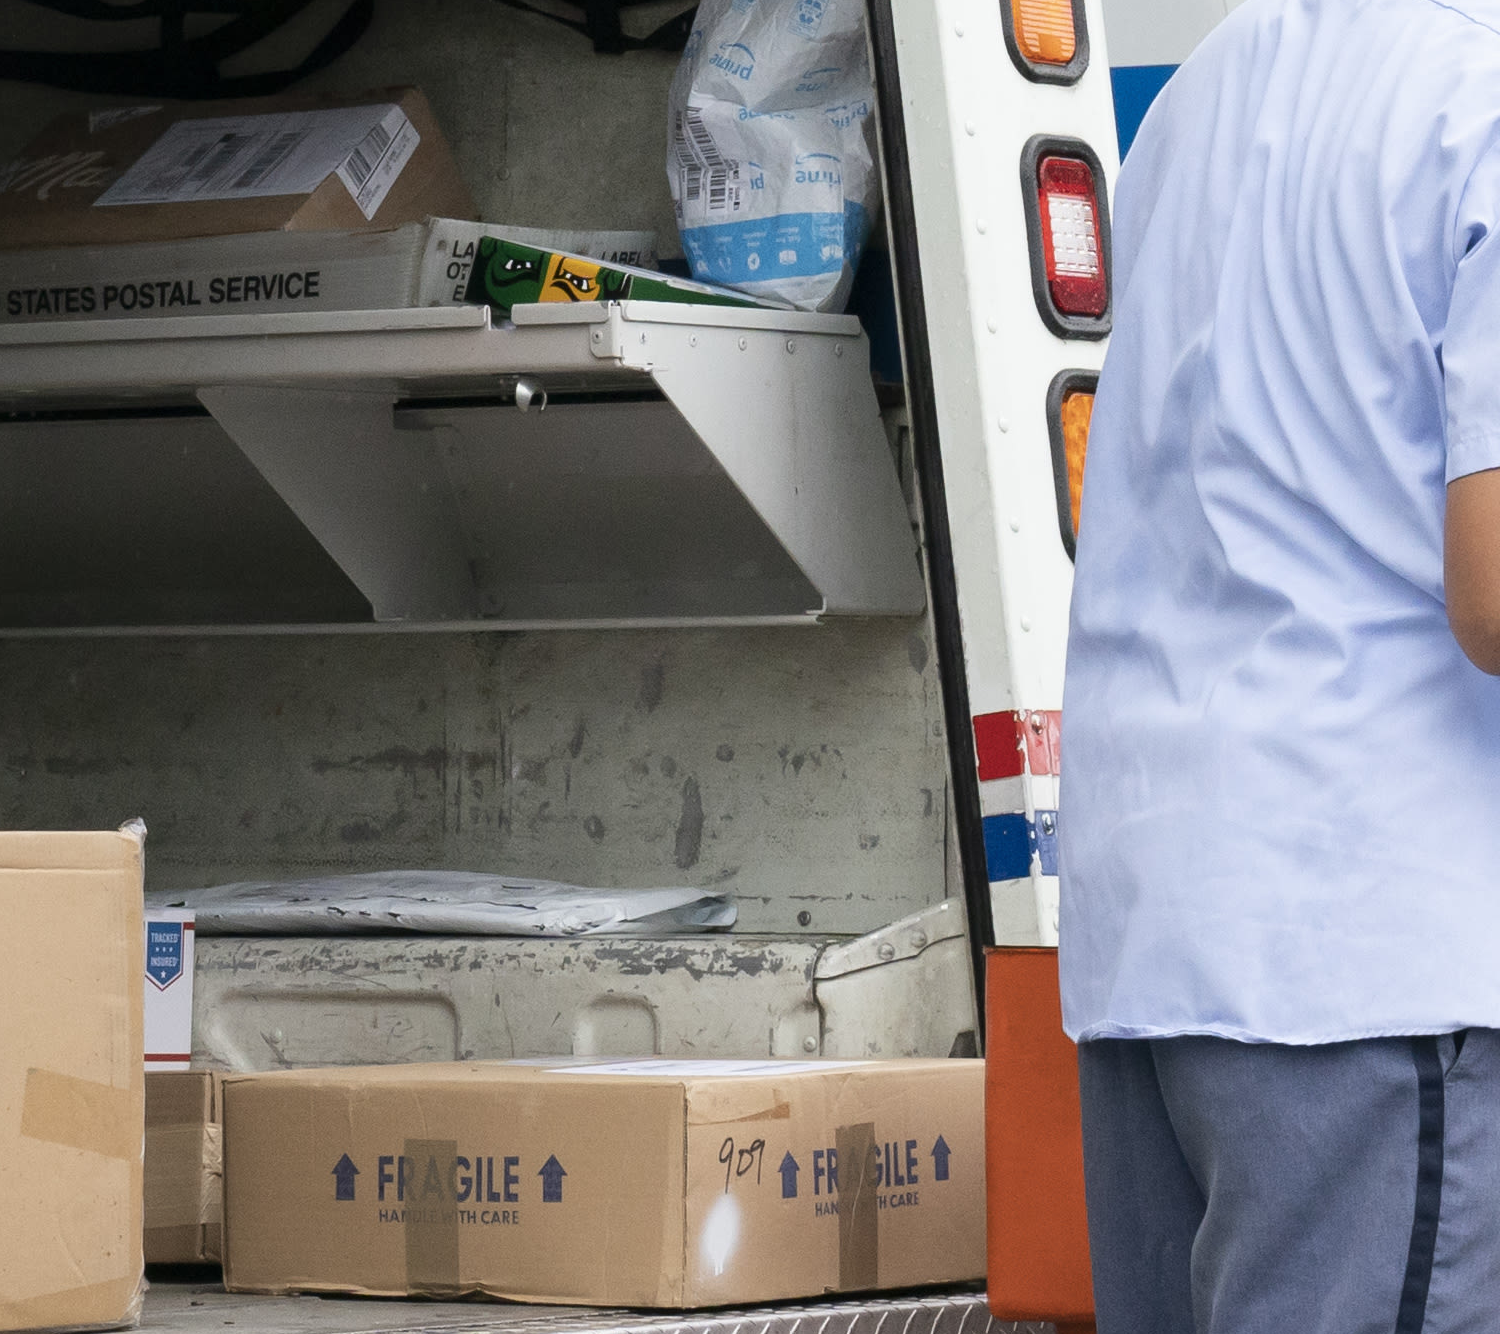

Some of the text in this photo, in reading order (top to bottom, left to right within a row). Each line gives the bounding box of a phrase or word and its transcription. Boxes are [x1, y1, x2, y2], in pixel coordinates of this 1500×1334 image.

[7, 287, 96, 316] STATES
[103, 280, 200, 311] POSTAL
[208, 270, 320, 304] SERVICE
[378, 1155, 519, 1203] FRAGILE
[890, 1192, 919, 1208] CARE
[480, 1210, 519, 1225] CARE
